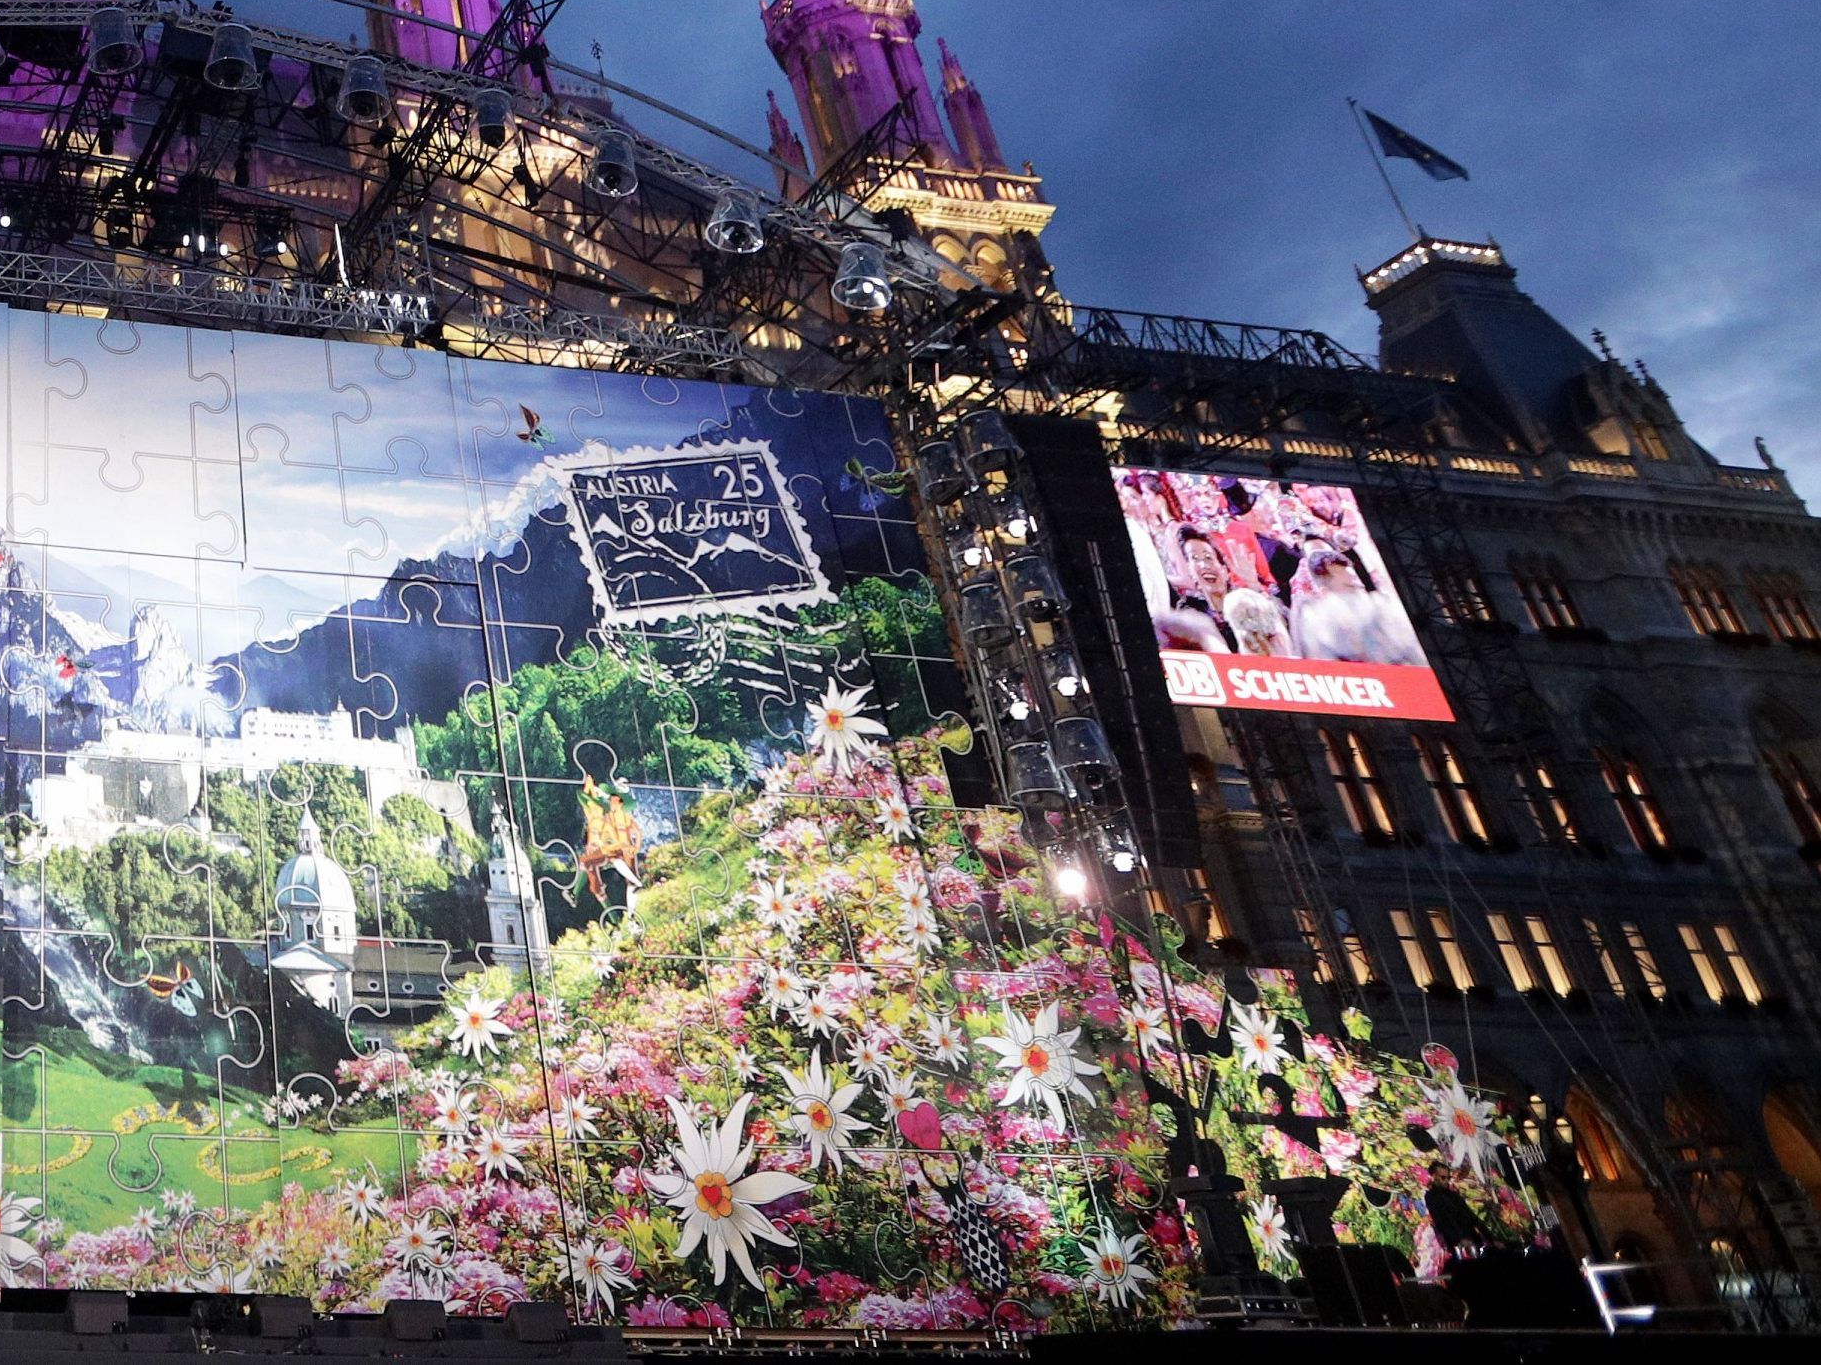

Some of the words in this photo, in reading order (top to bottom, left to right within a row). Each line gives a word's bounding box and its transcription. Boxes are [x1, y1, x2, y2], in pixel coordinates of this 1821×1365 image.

[586, 472, 679, 501] AUSTRIA
[713, 463, 764, 500] 25
[621, 500, 770, 538] Salzburg
[1163, 659, 1216, 696] DB
[1227, 668, 1394, 708] SCHENKER
